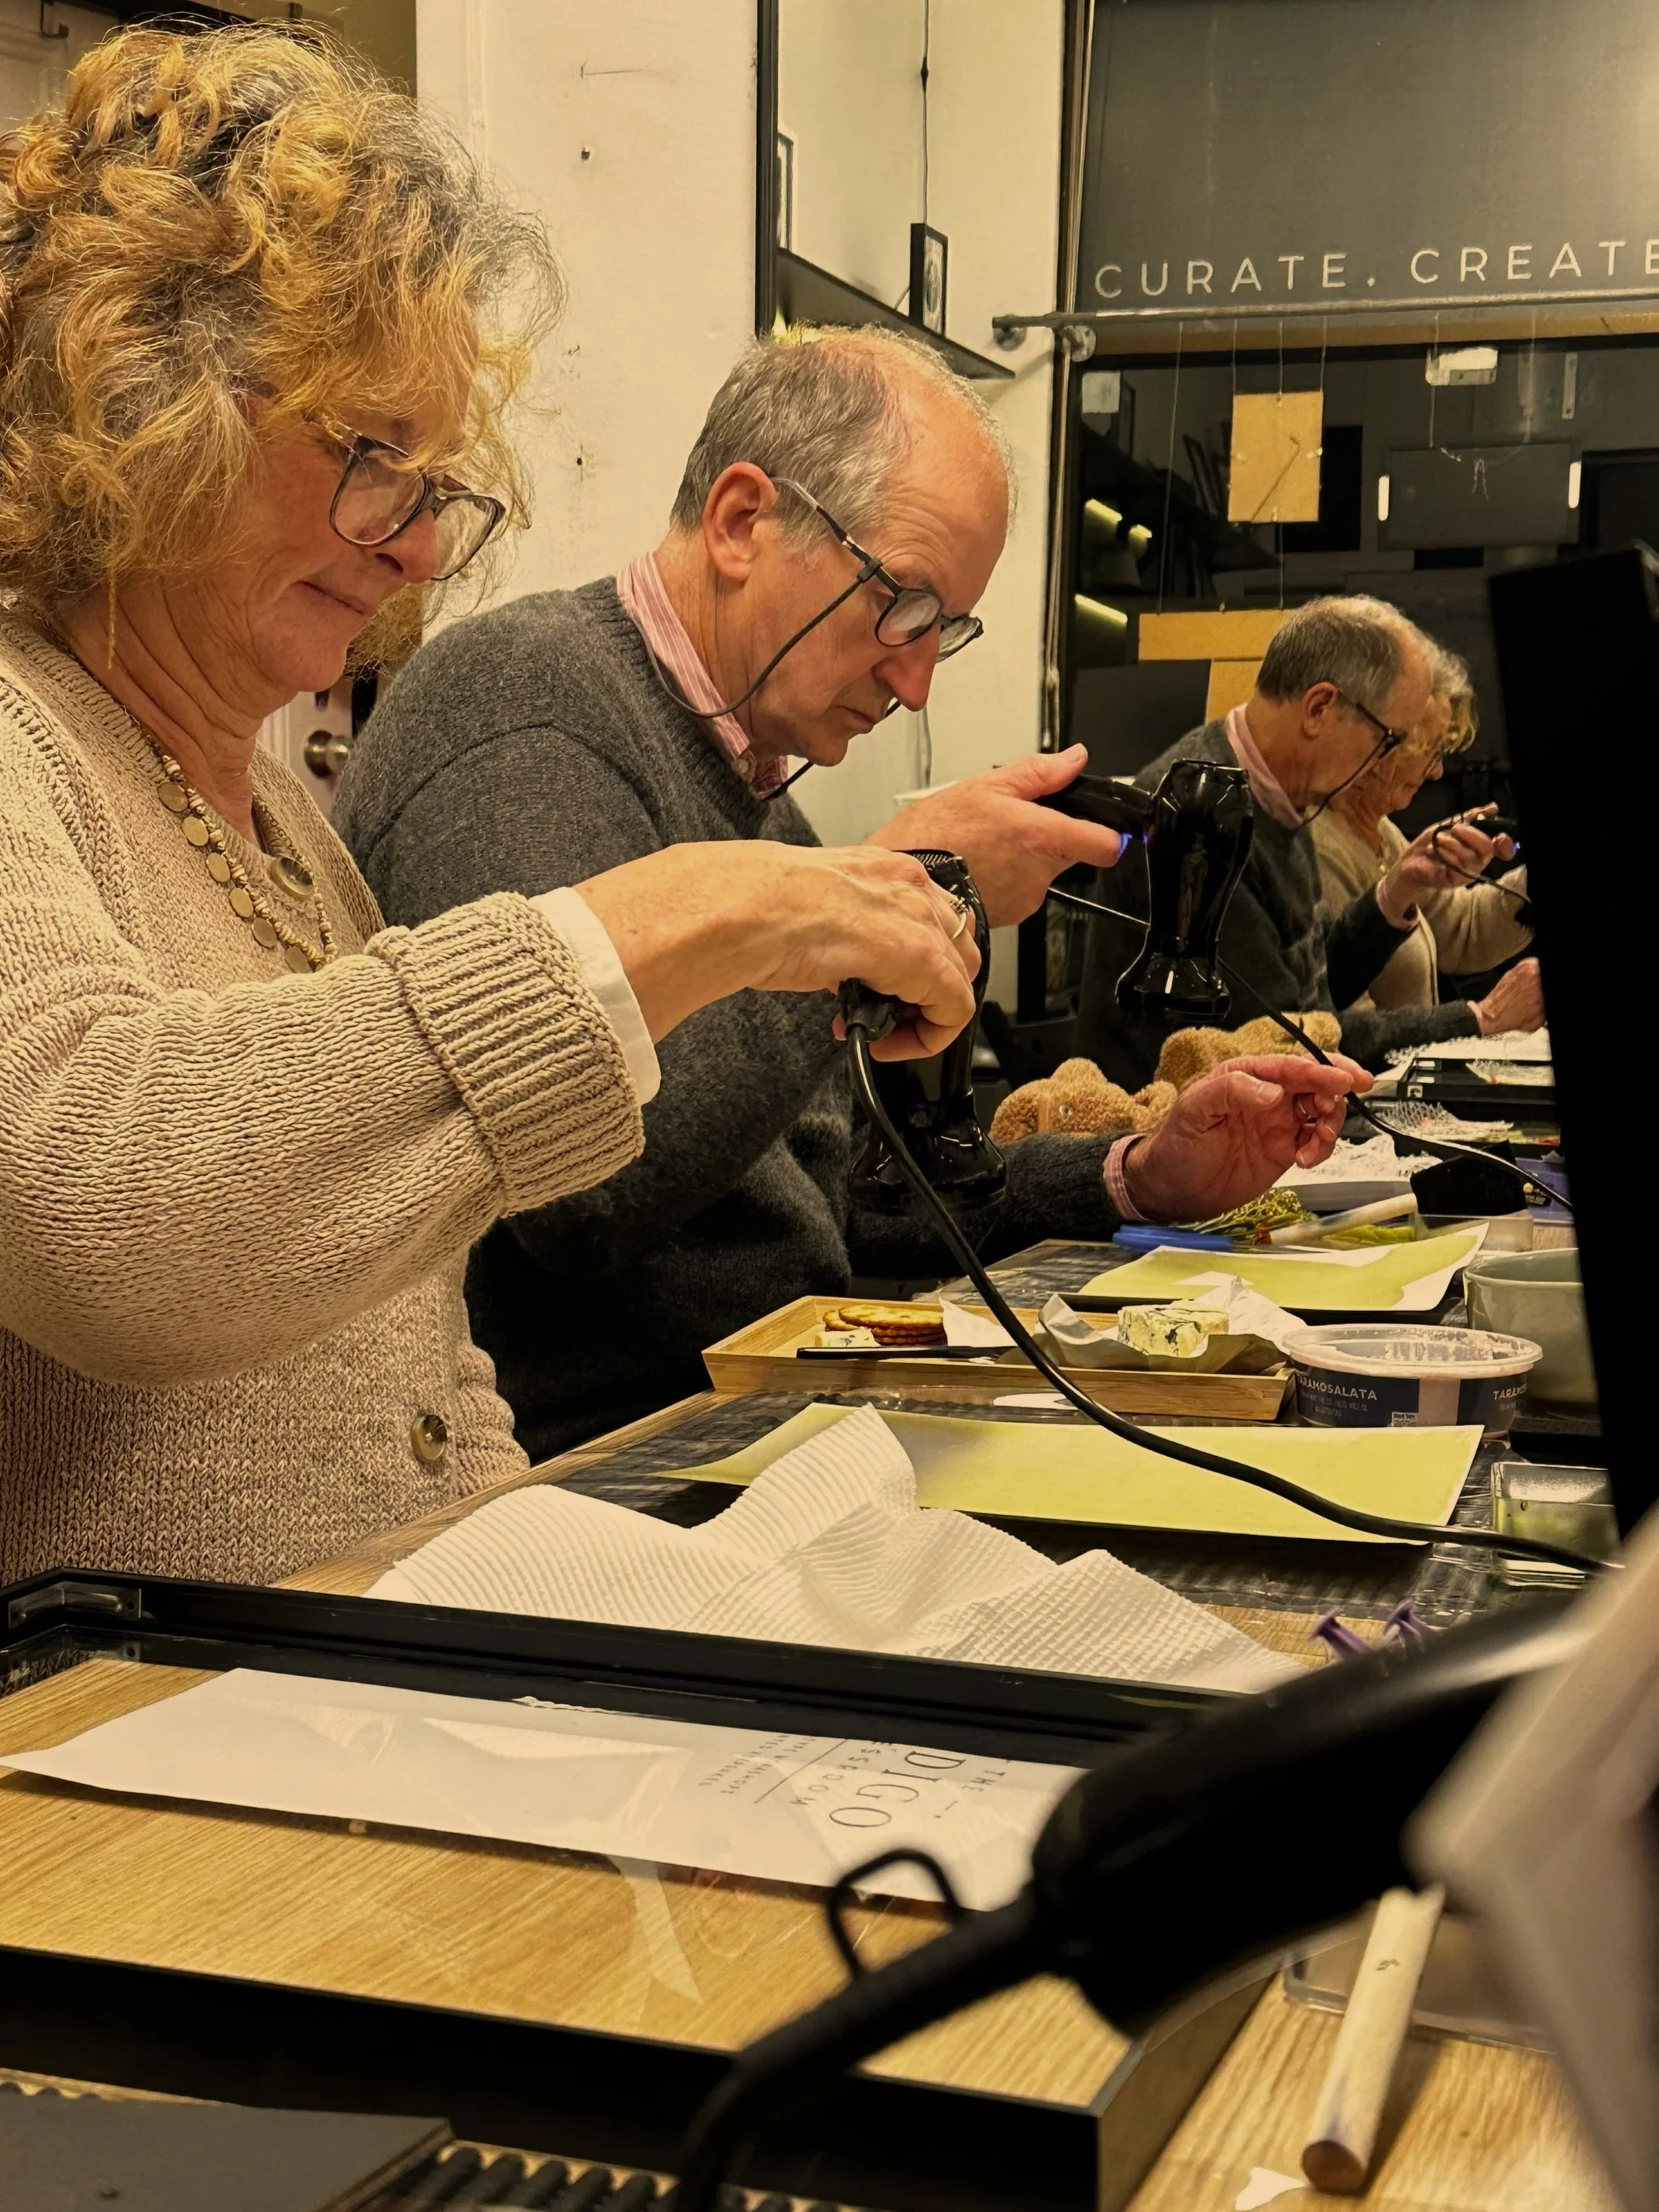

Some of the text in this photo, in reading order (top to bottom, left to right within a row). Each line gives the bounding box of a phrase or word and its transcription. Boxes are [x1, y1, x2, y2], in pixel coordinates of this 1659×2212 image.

[1094, 239, 1659, 299] CURATE. CREATE
[1299, 1376, 1377, 1401] ARAMOSALATA
